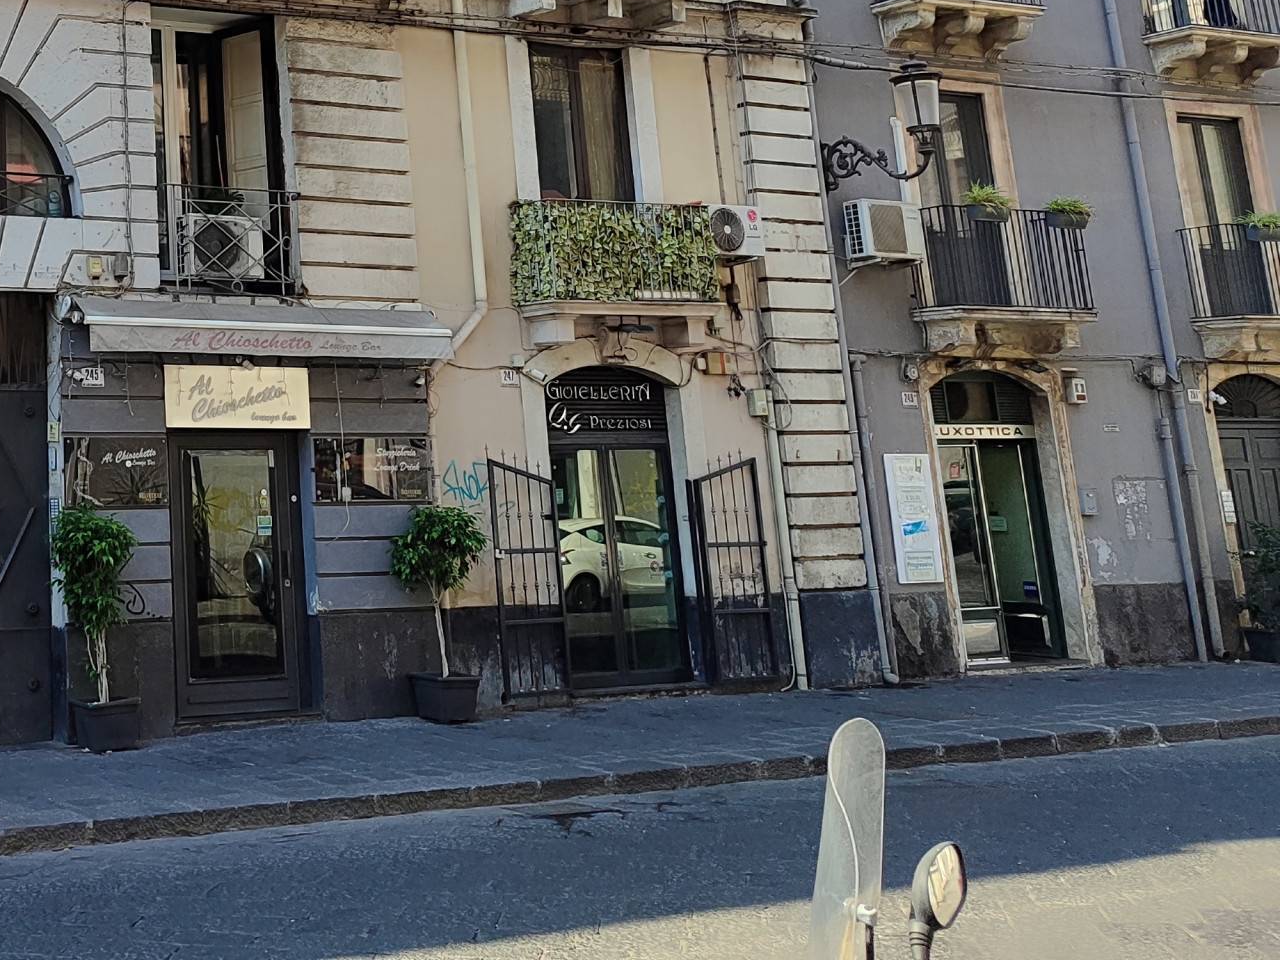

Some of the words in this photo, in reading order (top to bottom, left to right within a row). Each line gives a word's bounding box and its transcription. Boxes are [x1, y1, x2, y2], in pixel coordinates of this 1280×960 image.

[207, 330, 312, 350] Chioschetto
[361, 341, 382, 351] Bar
[85, 369, 99, 381] 245
[188, 374, 214, 400] Al
[935, 427, 1024, 437] UXOTTICA
[400, 461, 421, 472] Drink
